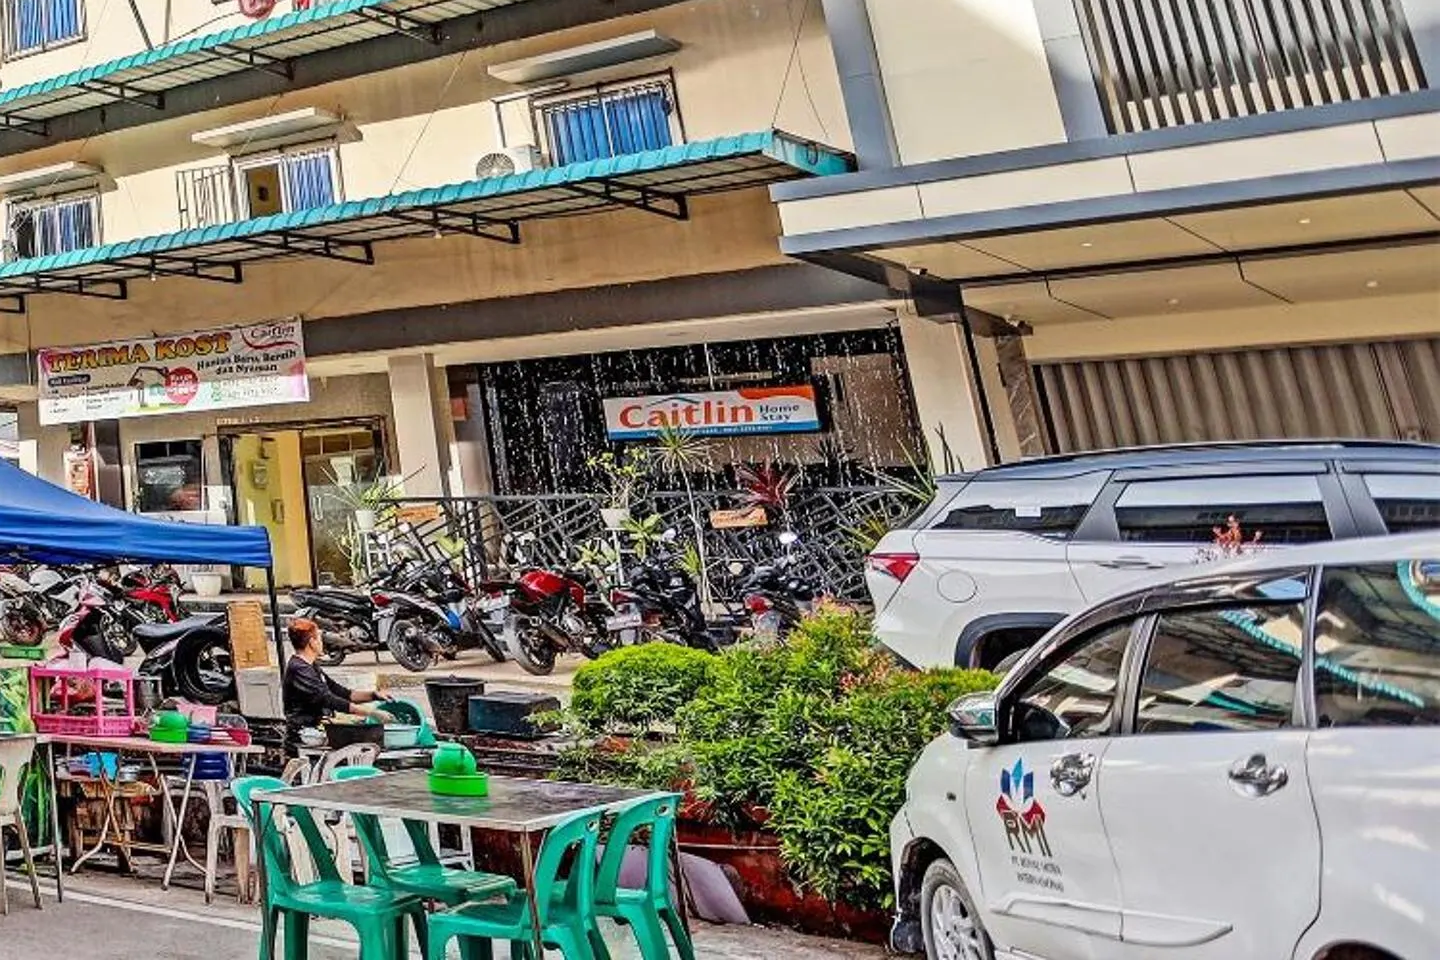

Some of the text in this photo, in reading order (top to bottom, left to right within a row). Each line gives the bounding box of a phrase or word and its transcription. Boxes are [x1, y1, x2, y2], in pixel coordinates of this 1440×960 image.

[155, 331, 233, 360] KOST
[619, 401, 754, 429] Caitlin
[759, 404, 800, 414] Home
[760, 413, 792, 423] Stay
[1003, 810, 1053, 857] RMI
